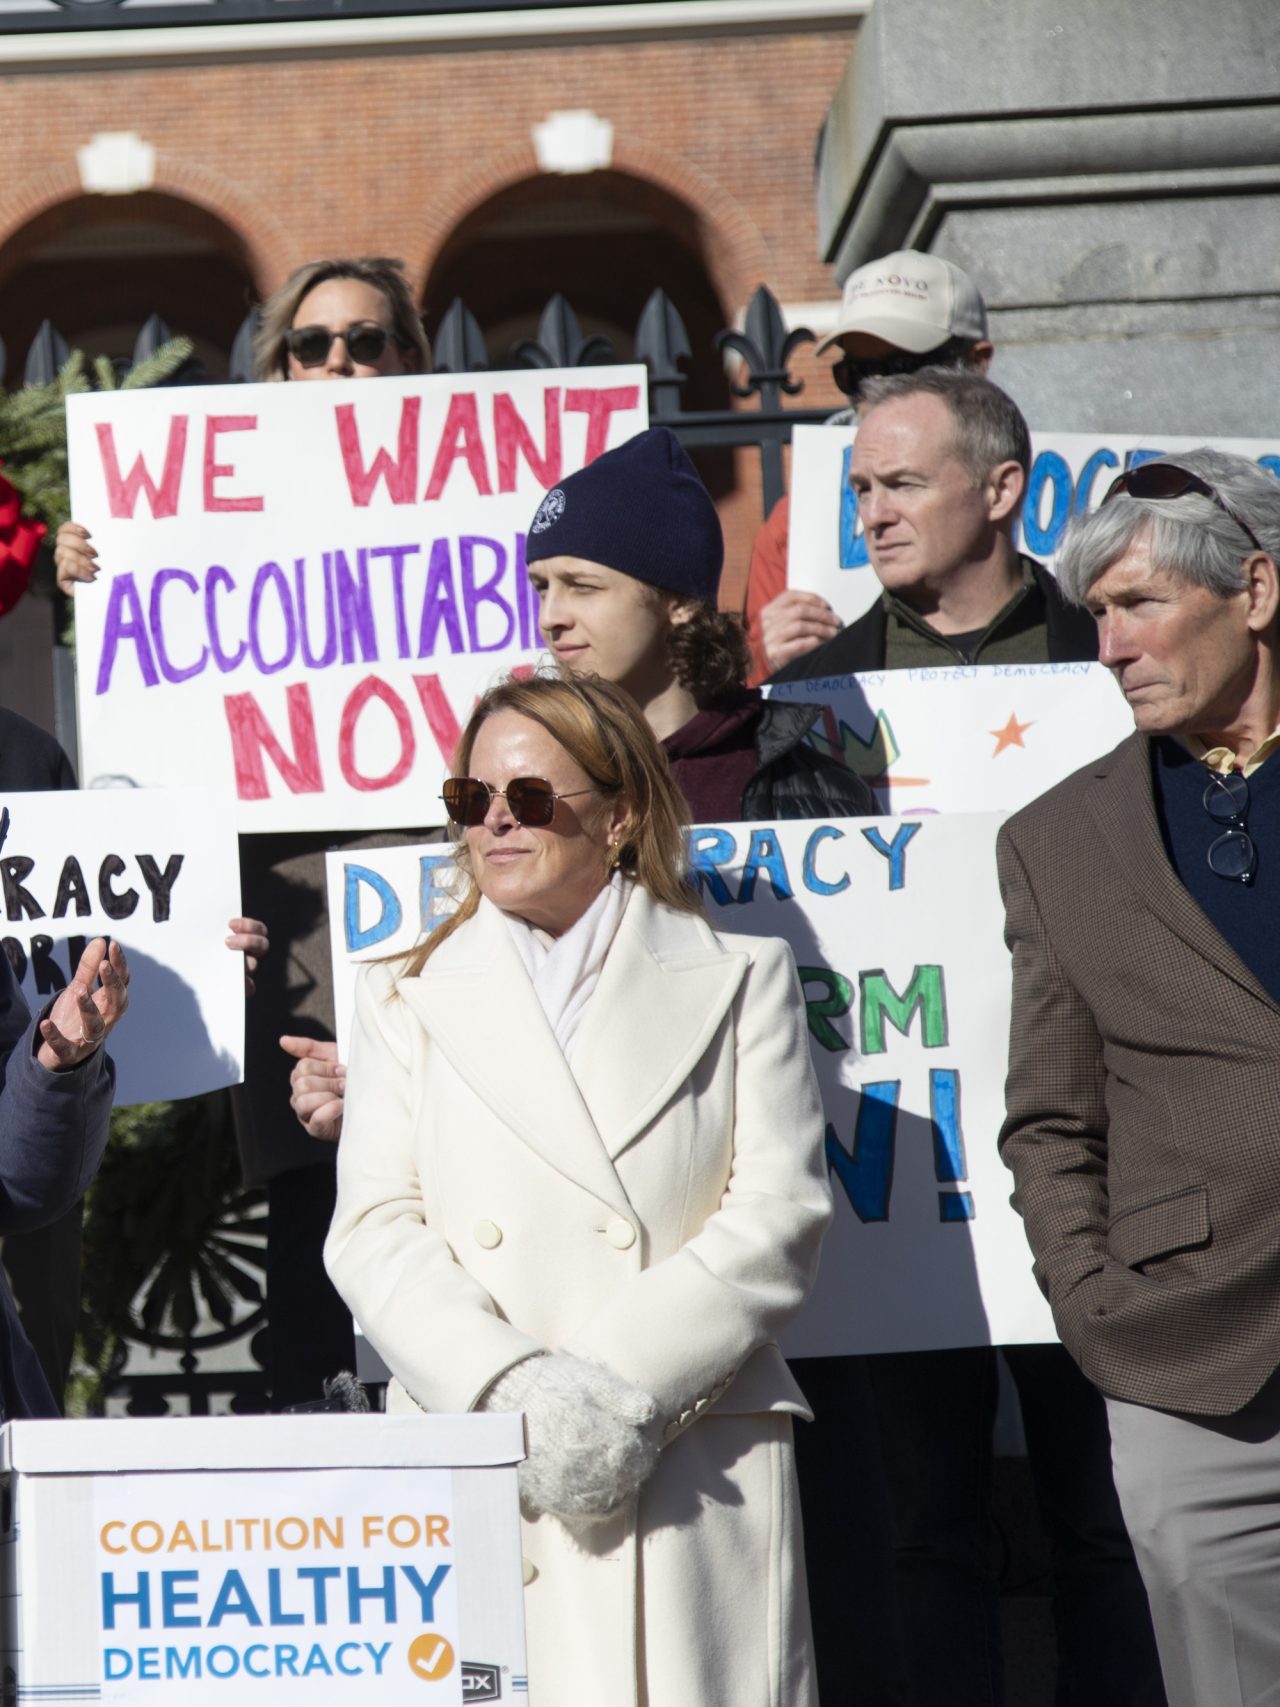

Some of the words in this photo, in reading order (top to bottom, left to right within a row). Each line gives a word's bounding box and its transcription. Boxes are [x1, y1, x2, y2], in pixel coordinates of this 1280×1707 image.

[94, 414, 264, 520] WE
[334, 385, 640, 507] WANT
[100, 1517, 344, 1554] COALITION
[363, 1514, 451, 1548] FOR
[100, 1563, 452, 1630] HEALTHY
[103, 1641, 392, 1681] DEMOCRACY
[462, 1675, 491, 1690] OX
